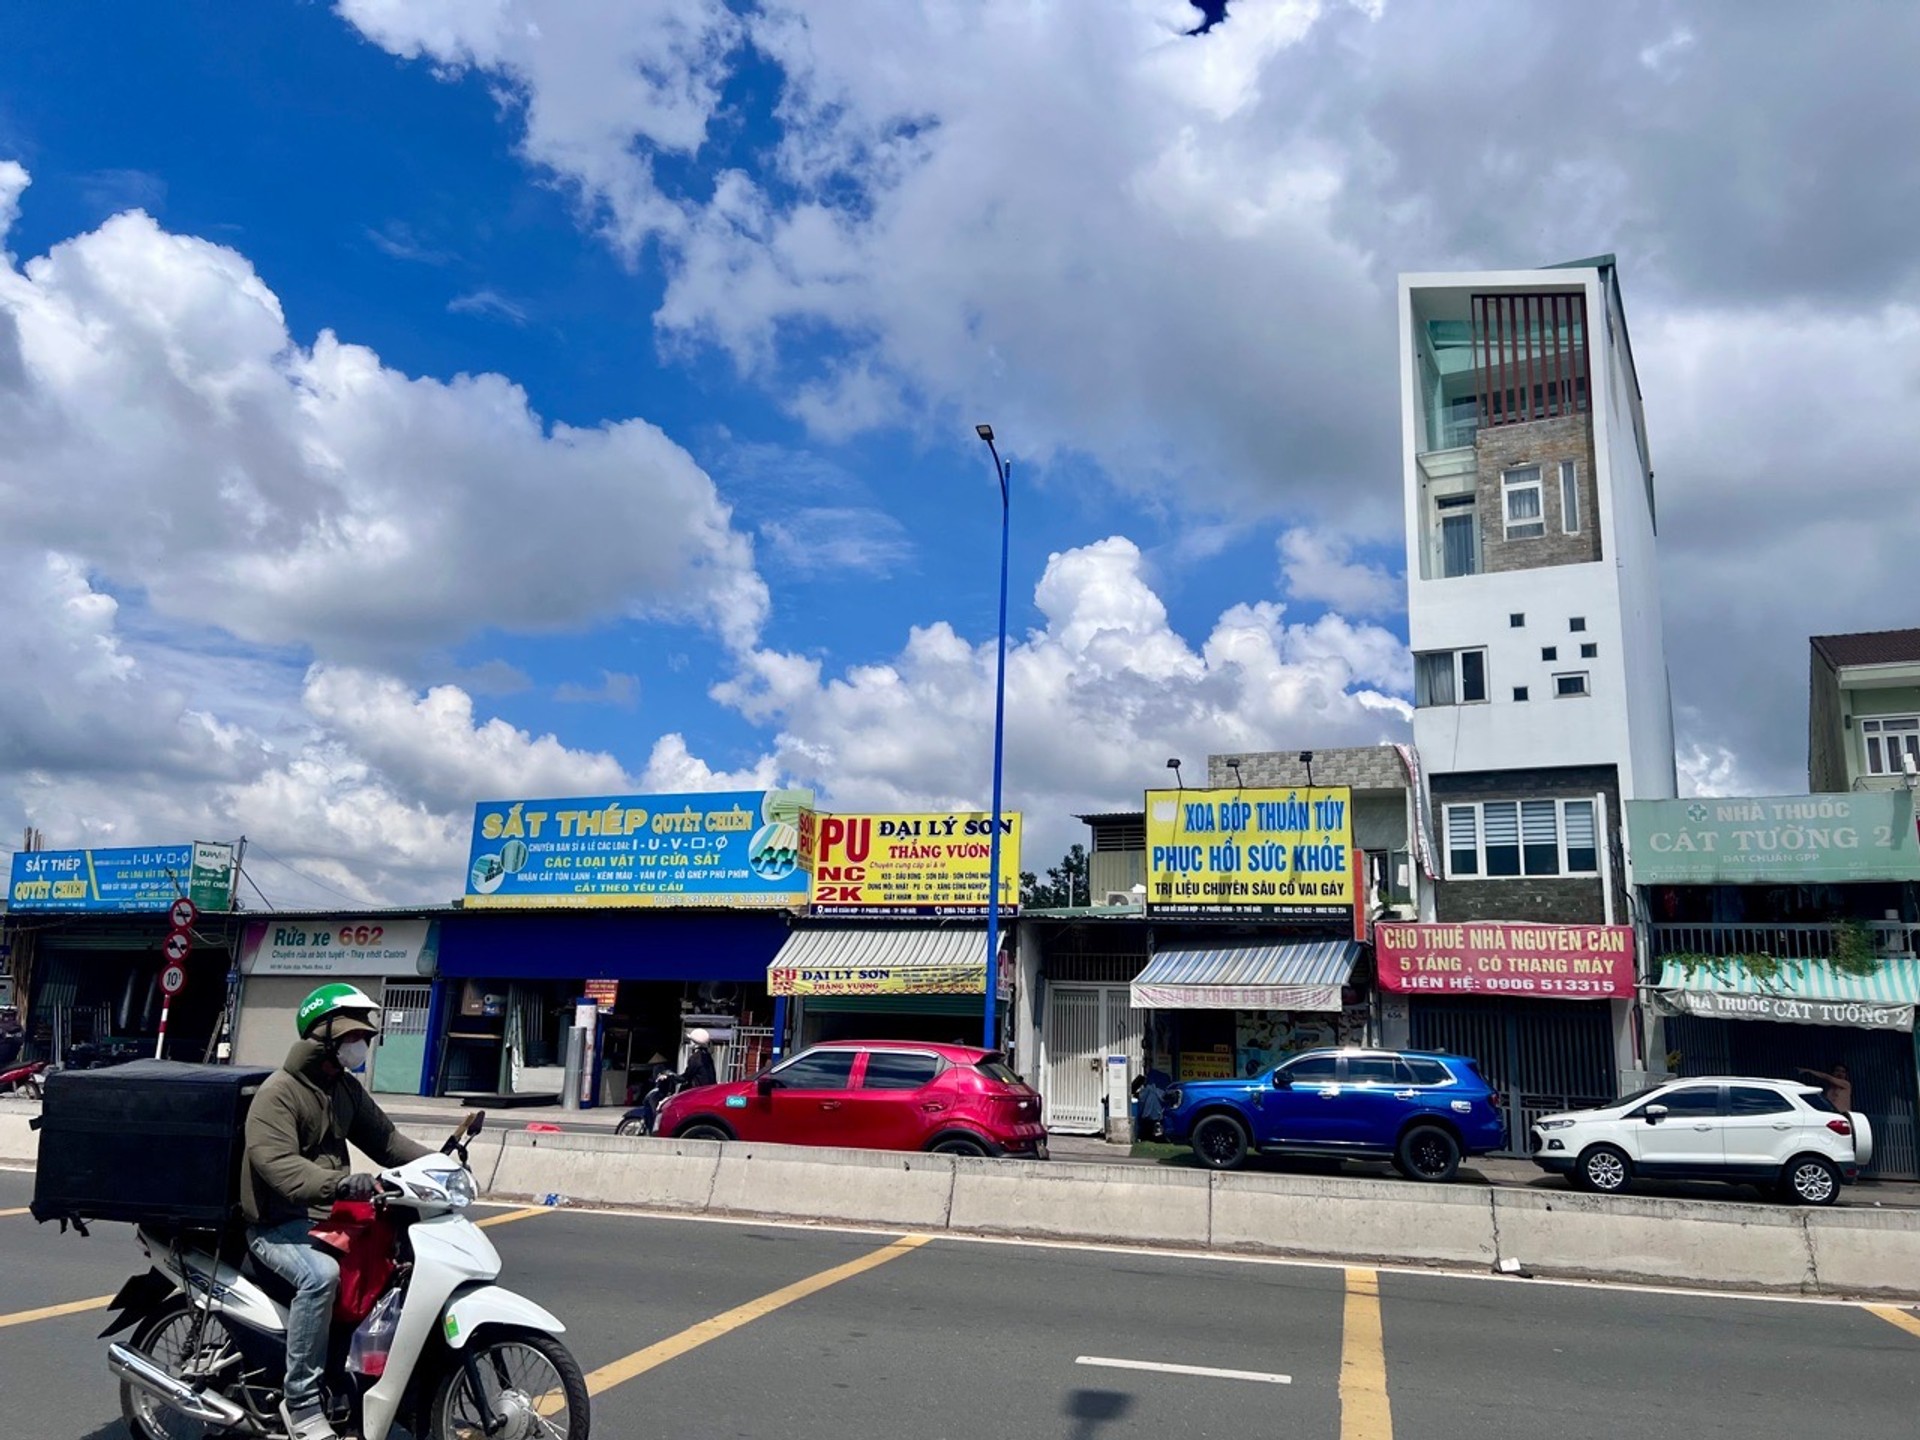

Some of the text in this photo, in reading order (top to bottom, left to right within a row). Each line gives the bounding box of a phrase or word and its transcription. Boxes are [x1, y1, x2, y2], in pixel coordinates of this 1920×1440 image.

[1184, 802, 1216, 833] XOA
[1255, 791, 1309, 833] THUẦN
[1313, 795, 1345, 833] TÚY
[1717, 796, 1850, 822] NHÀ THUỐC
[482, 803, 548, 839] SẮT
[556, 803, 648, 836] THÉP
[879, 820, 921, 840] ĐẠI
[928, 816, 958, 836] LÝ
[819, 818, 871, 863] PU
[1650, 824, 1894, 852] CÁT TƯỜNG 2
[889, 839, 1001, 859] THẮNG VƯƠN
[1153, 836, 1346, 877] PHỤC HỒI SỨC KHỎE
[51, 855, 81, 871] THÉP
[544, 856, 571, 868] CÁC
[575, 856, 606, 869] LOẠI
[610, 854, 634, 869] VẬT
[818, 867, 865, 881] NC
[600, 883, 629, 892] THEO
[816, 887, 863, 901] 2K
[1155, 882, 1172, 898] TRỊ
[1175, 880, 1200, 898] LIỆU
[1203, 880, 1248, 896] CHUYÊN
[1252, 879, 1275, 895] SÂU
[1299, 882, 1318, 895] VAI
[1321, 880, 1344, 896] GÁY
[274, 925, 384, 946] Rửa xe 662
[1384, 925, 1625, 952] CHO THUÊ NHÀ NGUYÊN CĂN
[772, 968, 797, 981] PU
[1400, 958, 1411, 971] 5
[1478, 955, 1501, 972] CÓ
[1507, 959, 1568, 973] THANG
[1573, 956, 1614, 974] MÁY
[1401, 975, 1615, 991] LIÊN HỆ: 0906 513315
[300, 998, 324, 1018] Grab
[1716, 994, 1770, 1013] THUỐC
[1896, 1010, 1909, 1026] 2
